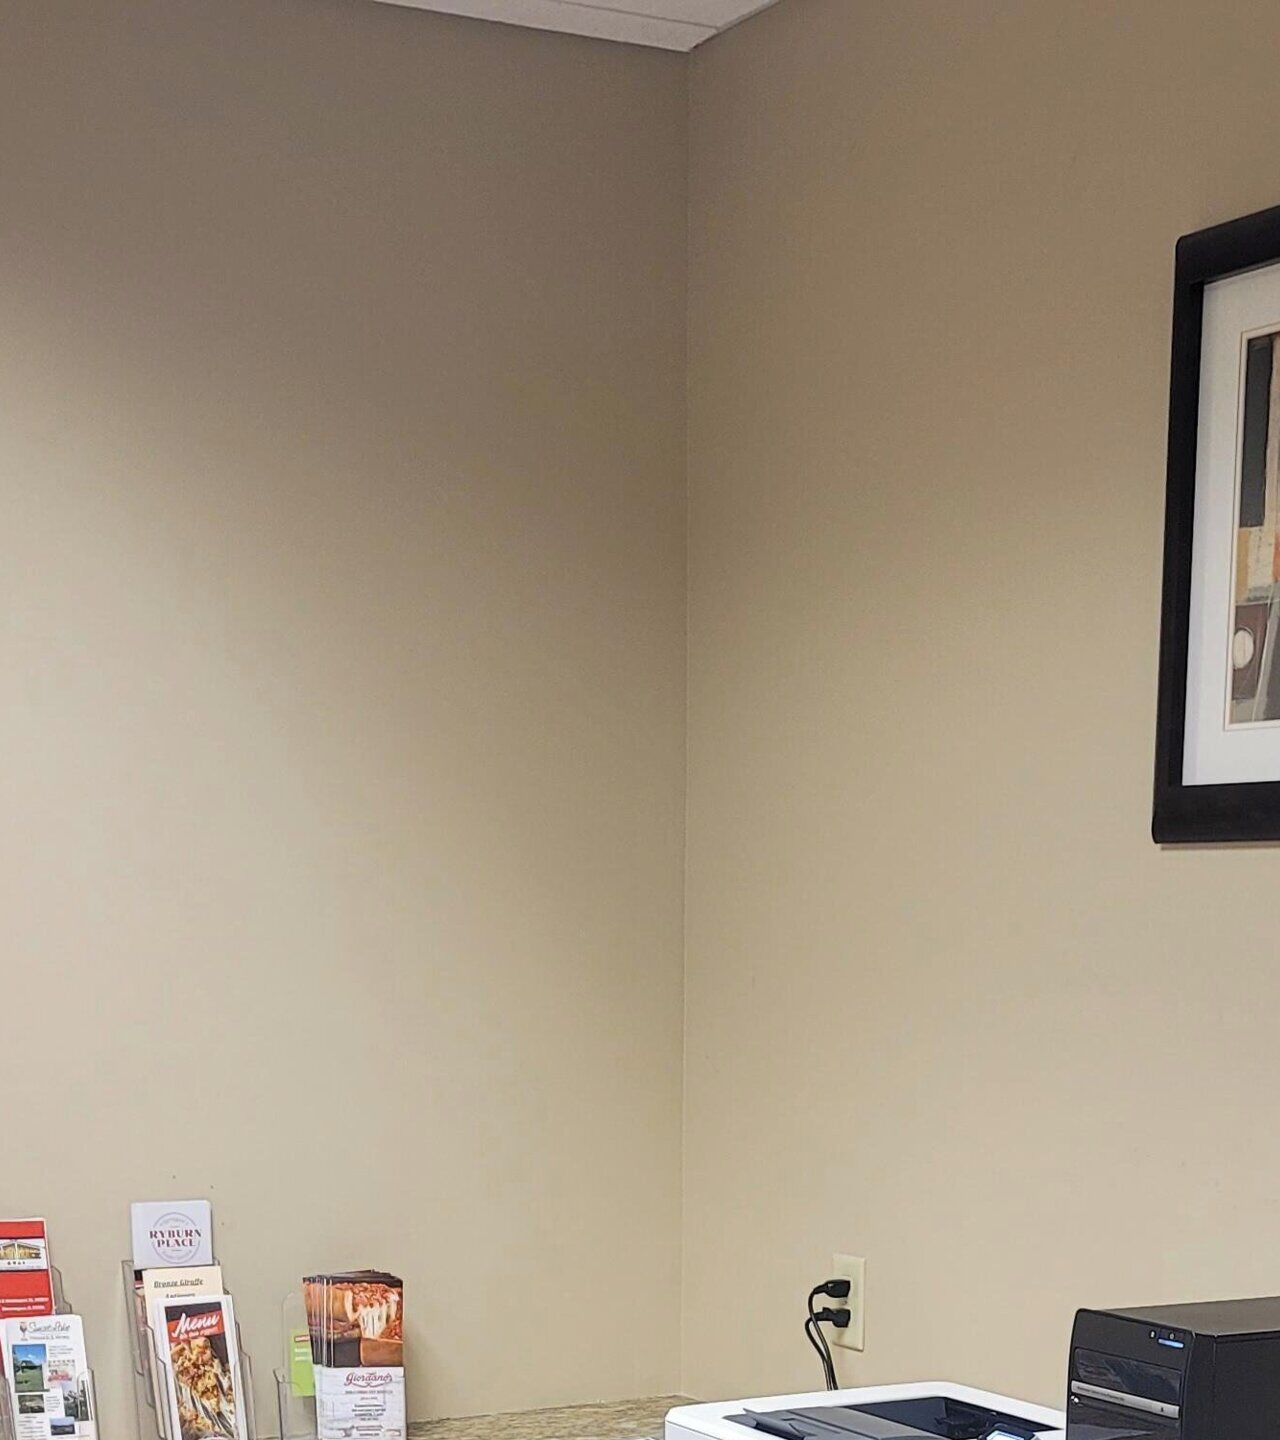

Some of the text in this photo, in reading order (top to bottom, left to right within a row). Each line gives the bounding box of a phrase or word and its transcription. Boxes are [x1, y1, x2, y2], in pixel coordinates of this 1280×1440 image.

[149, 1229, 202, 1239] RYBURN
[157, 1239, 197, 1248] PLACE
[171, 1312, 220, 1338] Menu
[343, 1372, 393, 1388] Giordano's
